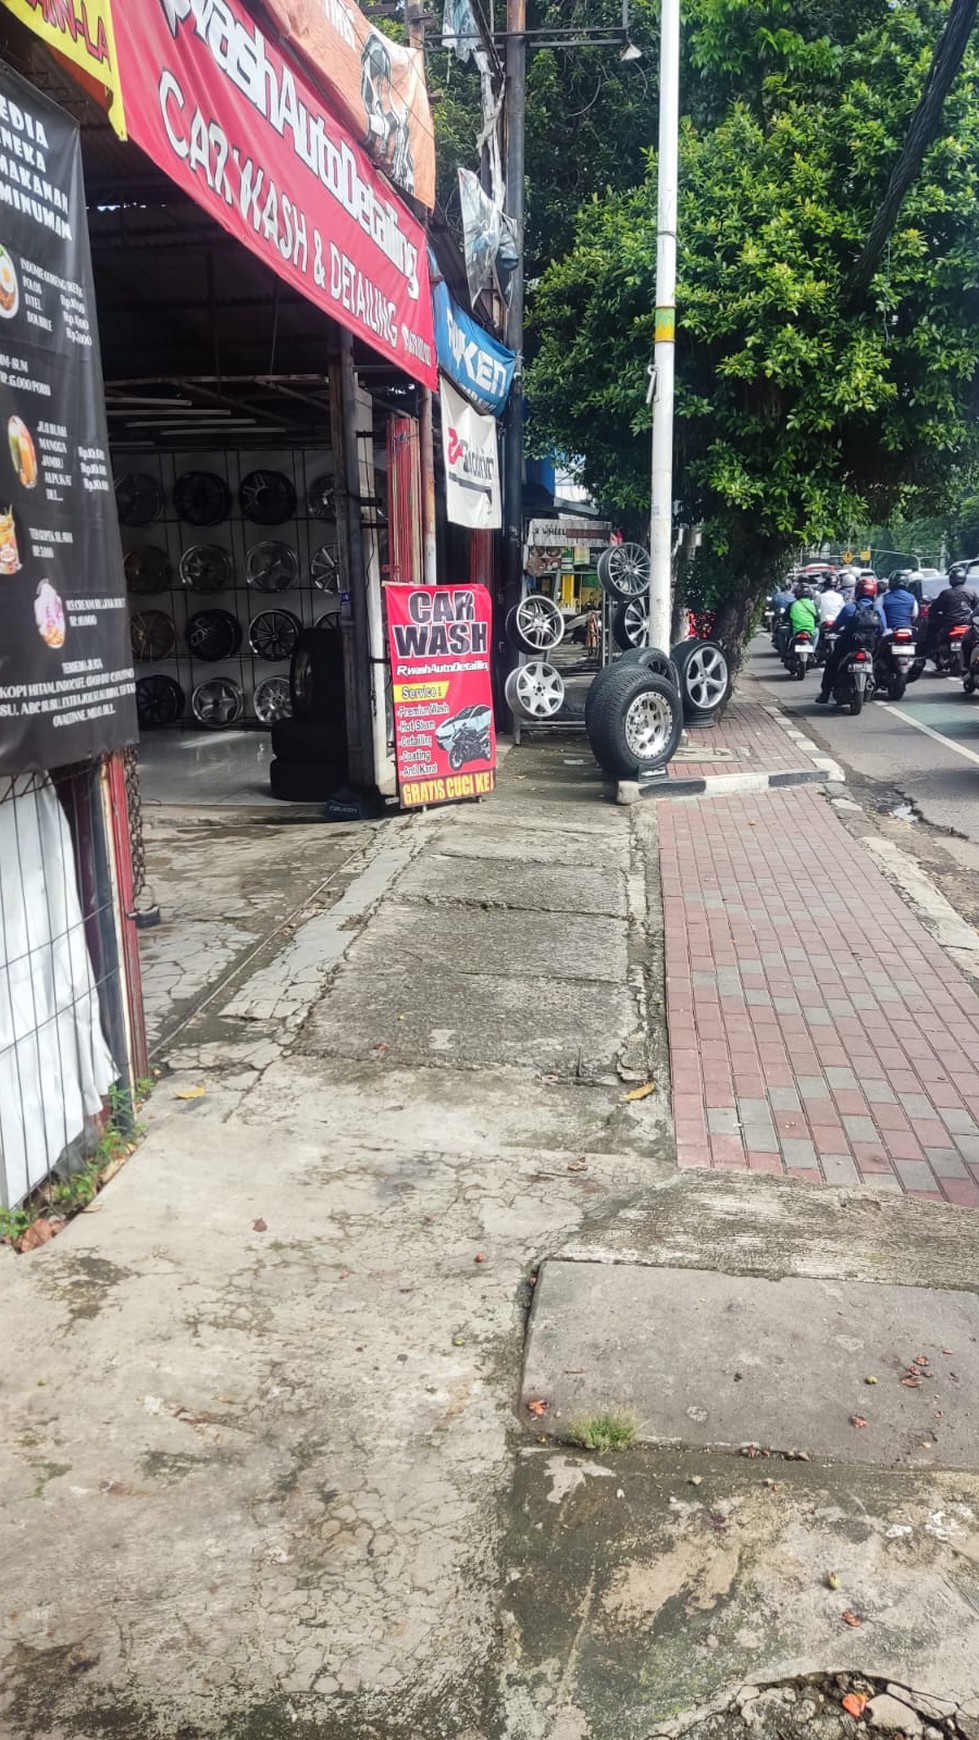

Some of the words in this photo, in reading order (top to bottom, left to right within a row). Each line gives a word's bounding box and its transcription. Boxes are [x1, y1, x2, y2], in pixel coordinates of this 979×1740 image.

[158, 66, 234, 206] CAR
[233, 147, 308, 274] WASH
[312, 227, 326, 292] &
[329, 240, 399, 350] DETAILING
[408, 591, 475, 625] CAR
[393, 621, 488, 659] WASH
[402, 685, 437, 699] Service
[402, 777, 446, 807] GRATIS
[446, 773, 476, 800] CUCI
